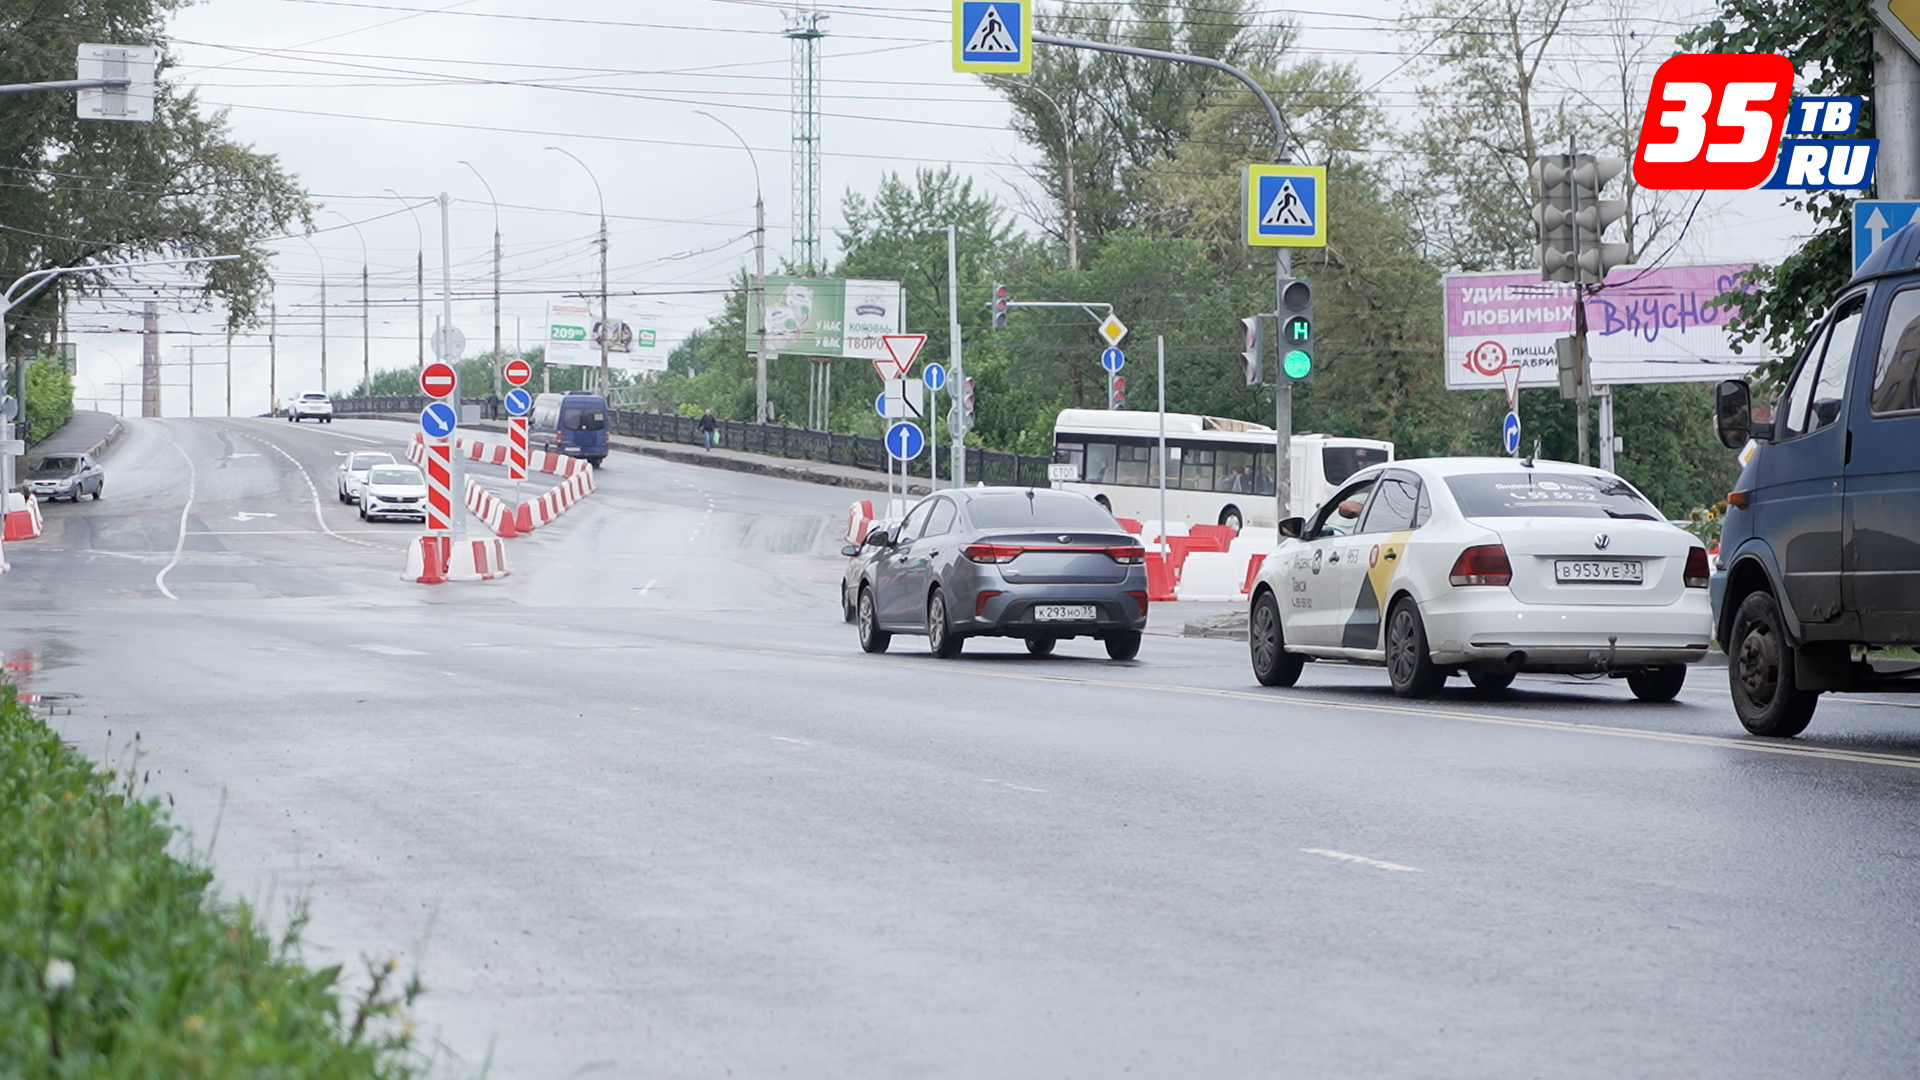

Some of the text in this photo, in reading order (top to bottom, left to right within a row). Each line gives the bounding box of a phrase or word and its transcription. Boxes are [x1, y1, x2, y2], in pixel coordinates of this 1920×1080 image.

[1462, 305, 1576, 326] ЛЮБИМЫХ
[1589, 291, 1718, 343] ВКУСНО
[823, 321, 842, 332] НАС
[552, 327, 575, 339] 209
[848, 336, 888, 351] ТВОРО
[1512, 346, 1555, 356] ПИЦЦА
[1053, 467, 1075, 478] СТОП
[1623, 563, 1637, 575] 33
